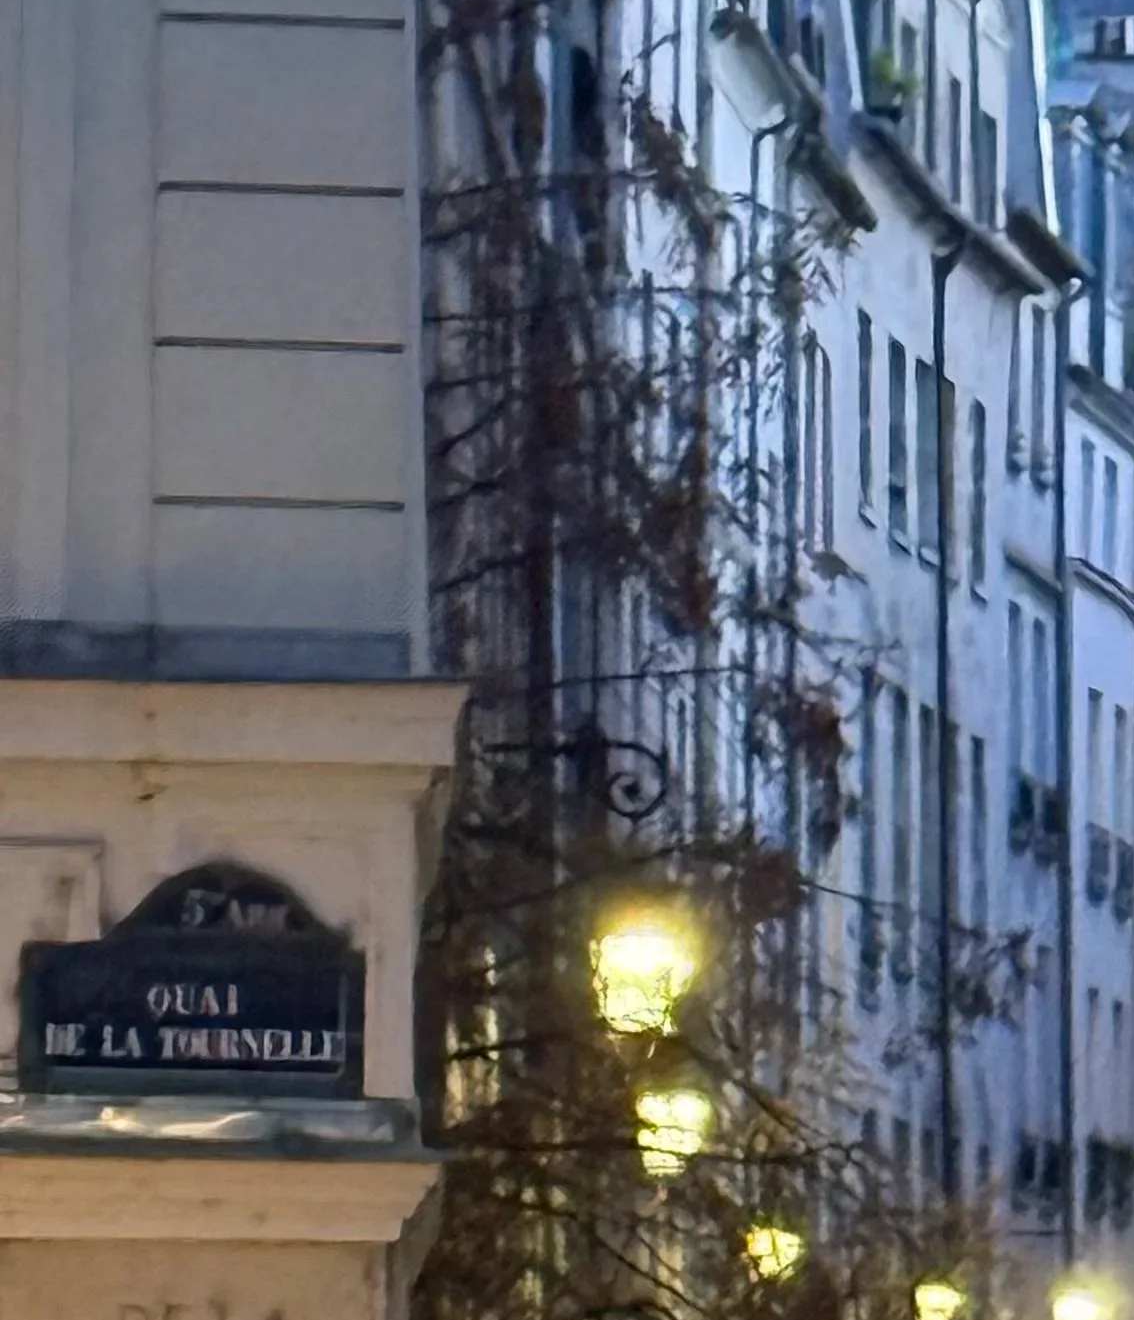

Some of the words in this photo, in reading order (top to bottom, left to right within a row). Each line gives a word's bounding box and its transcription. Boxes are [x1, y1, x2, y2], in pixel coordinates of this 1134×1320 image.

[147, 983, 238, 1018] QUAI
[45, 1022, 85, 1056] DE
[100, 1025, 143, 1058] LA
[158, 1027, 346, 1061] TOURNELLE
